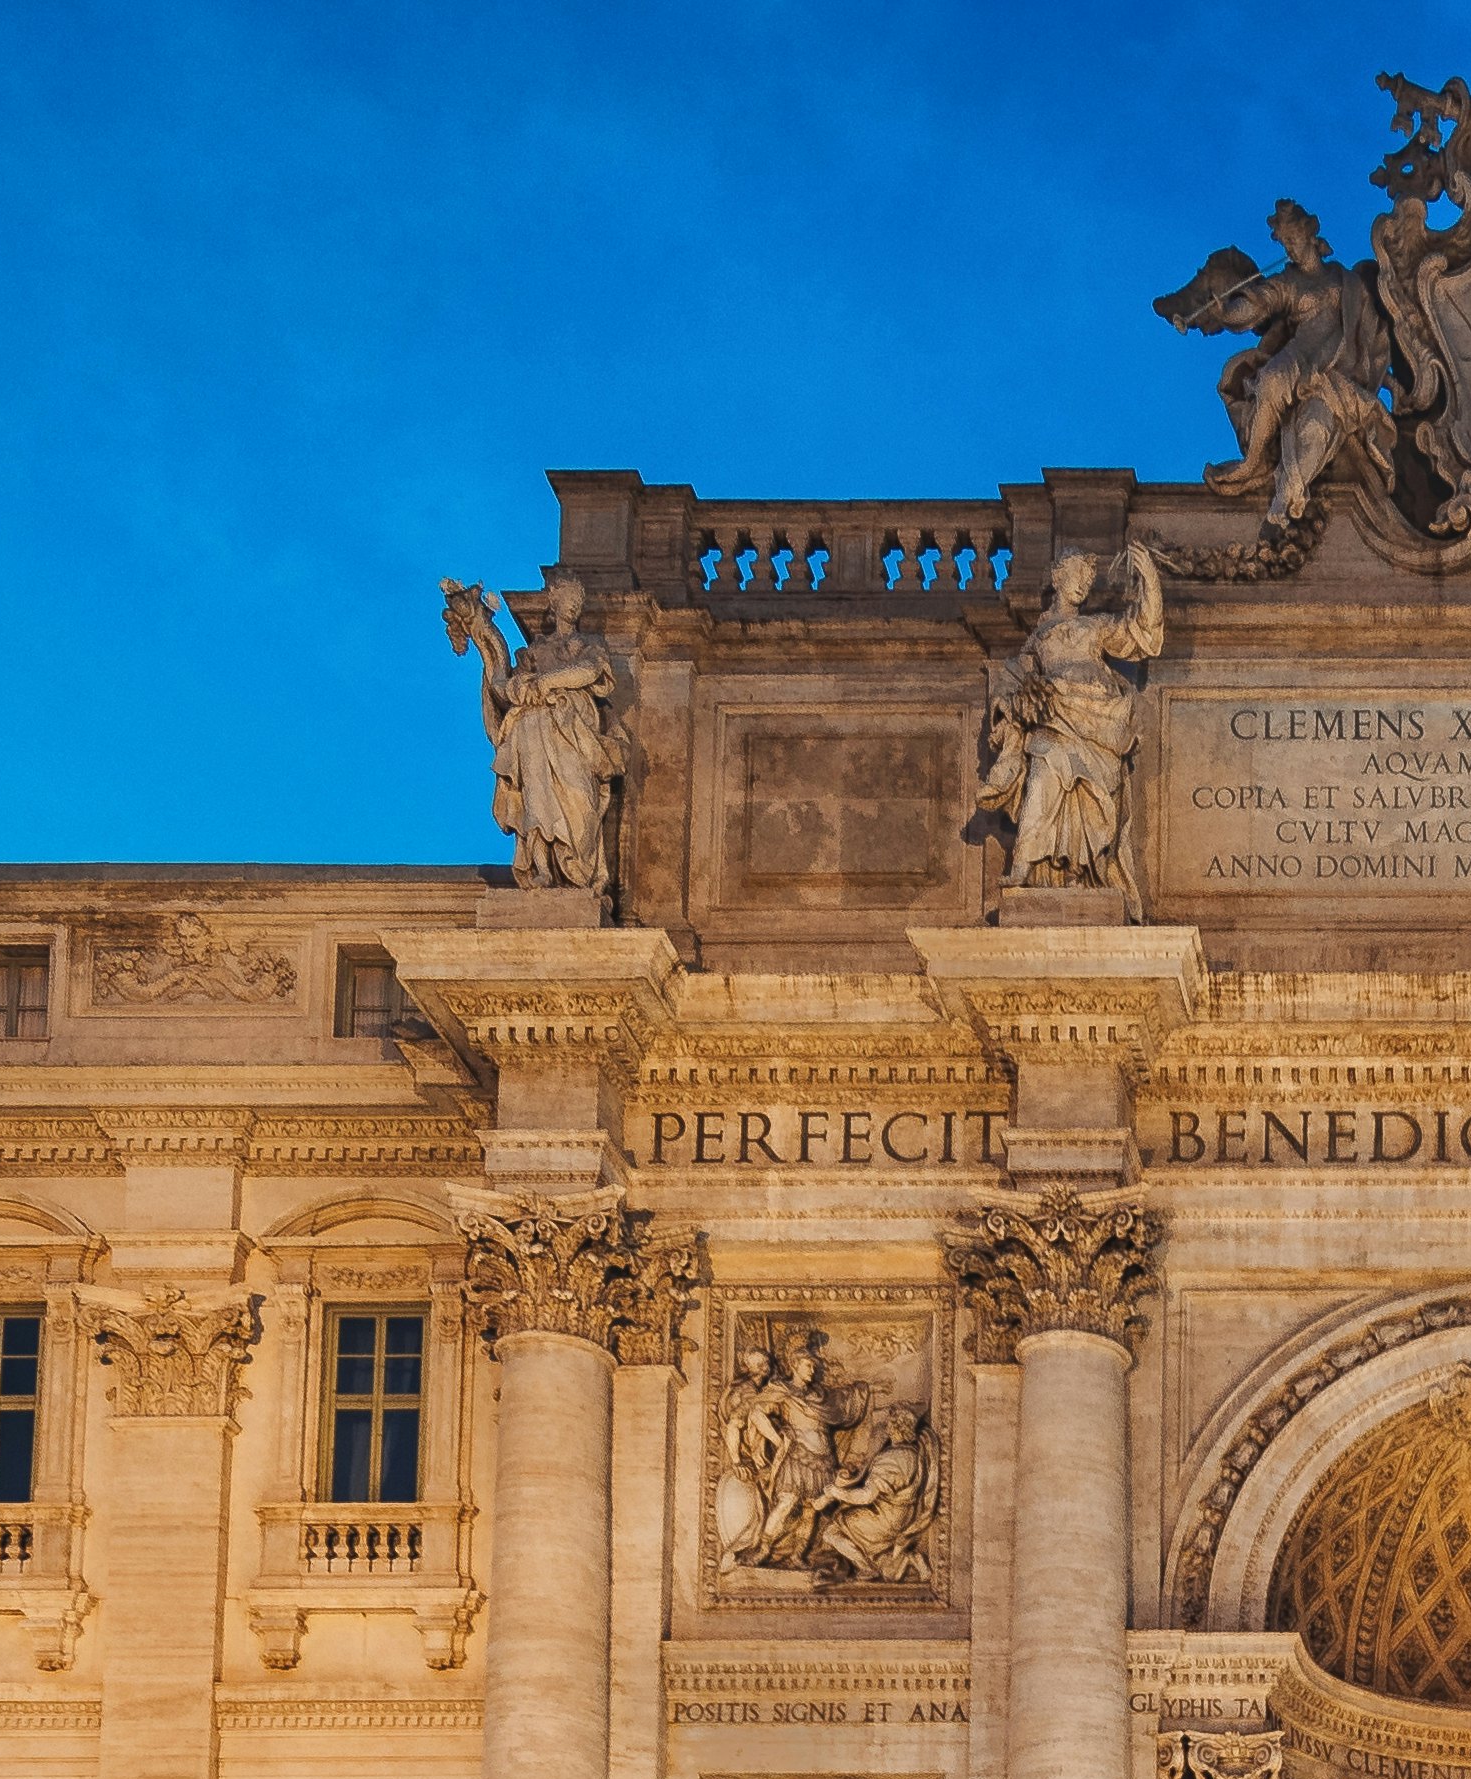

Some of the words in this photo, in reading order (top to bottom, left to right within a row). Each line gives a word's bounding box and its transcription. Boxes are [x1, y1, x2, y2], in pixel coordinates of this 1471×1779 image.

[1230, 709, 1425, 741] CLEMENS
[1192, 786, 1288, 809] COPIA
[1303, 786, 1340, 809] ET
[1275, 820, 1382, 844] CVLTV
[1203, 855, 1302, 878] ANNO
[1315, 855, 1437, 878] DOMINI
[647, 1110, 1009, 1165] PERFECIT
[673, 1702, 761, 1723] POSITIS
[772, 1702, 847, 1723] SIGNIS
[863, 1702, 893, 1723] ET
[1290, 1727, 1335, 1763] IVSSV
